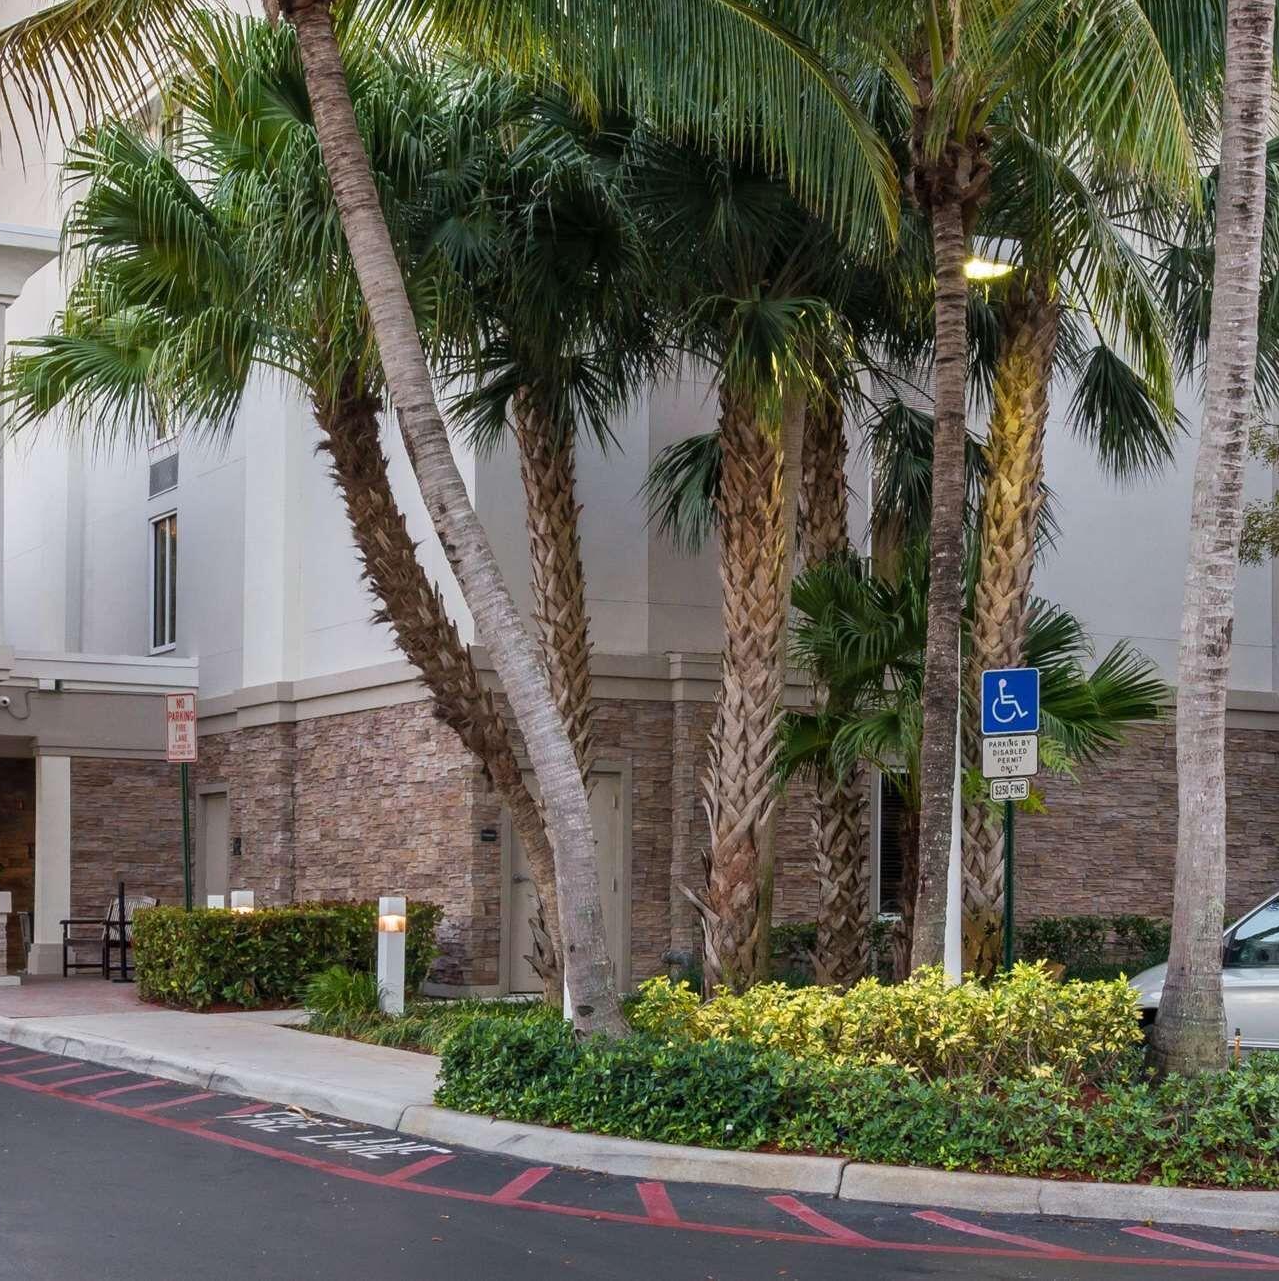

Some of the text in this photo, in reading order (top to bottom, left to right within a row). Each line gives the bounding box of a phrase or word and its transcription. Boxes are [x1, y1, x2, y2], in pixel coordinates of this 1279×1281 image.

[176, 698, 185, 709] NO
[168, 710, 195, 722] PARKING
[988, 740, 1019, 748] PARKING
[992, 748, 1028, 756] DISABLED
[997, 756, 1023, 764] PERMIT
[995, 783, 1025, 795] $250 FINE
